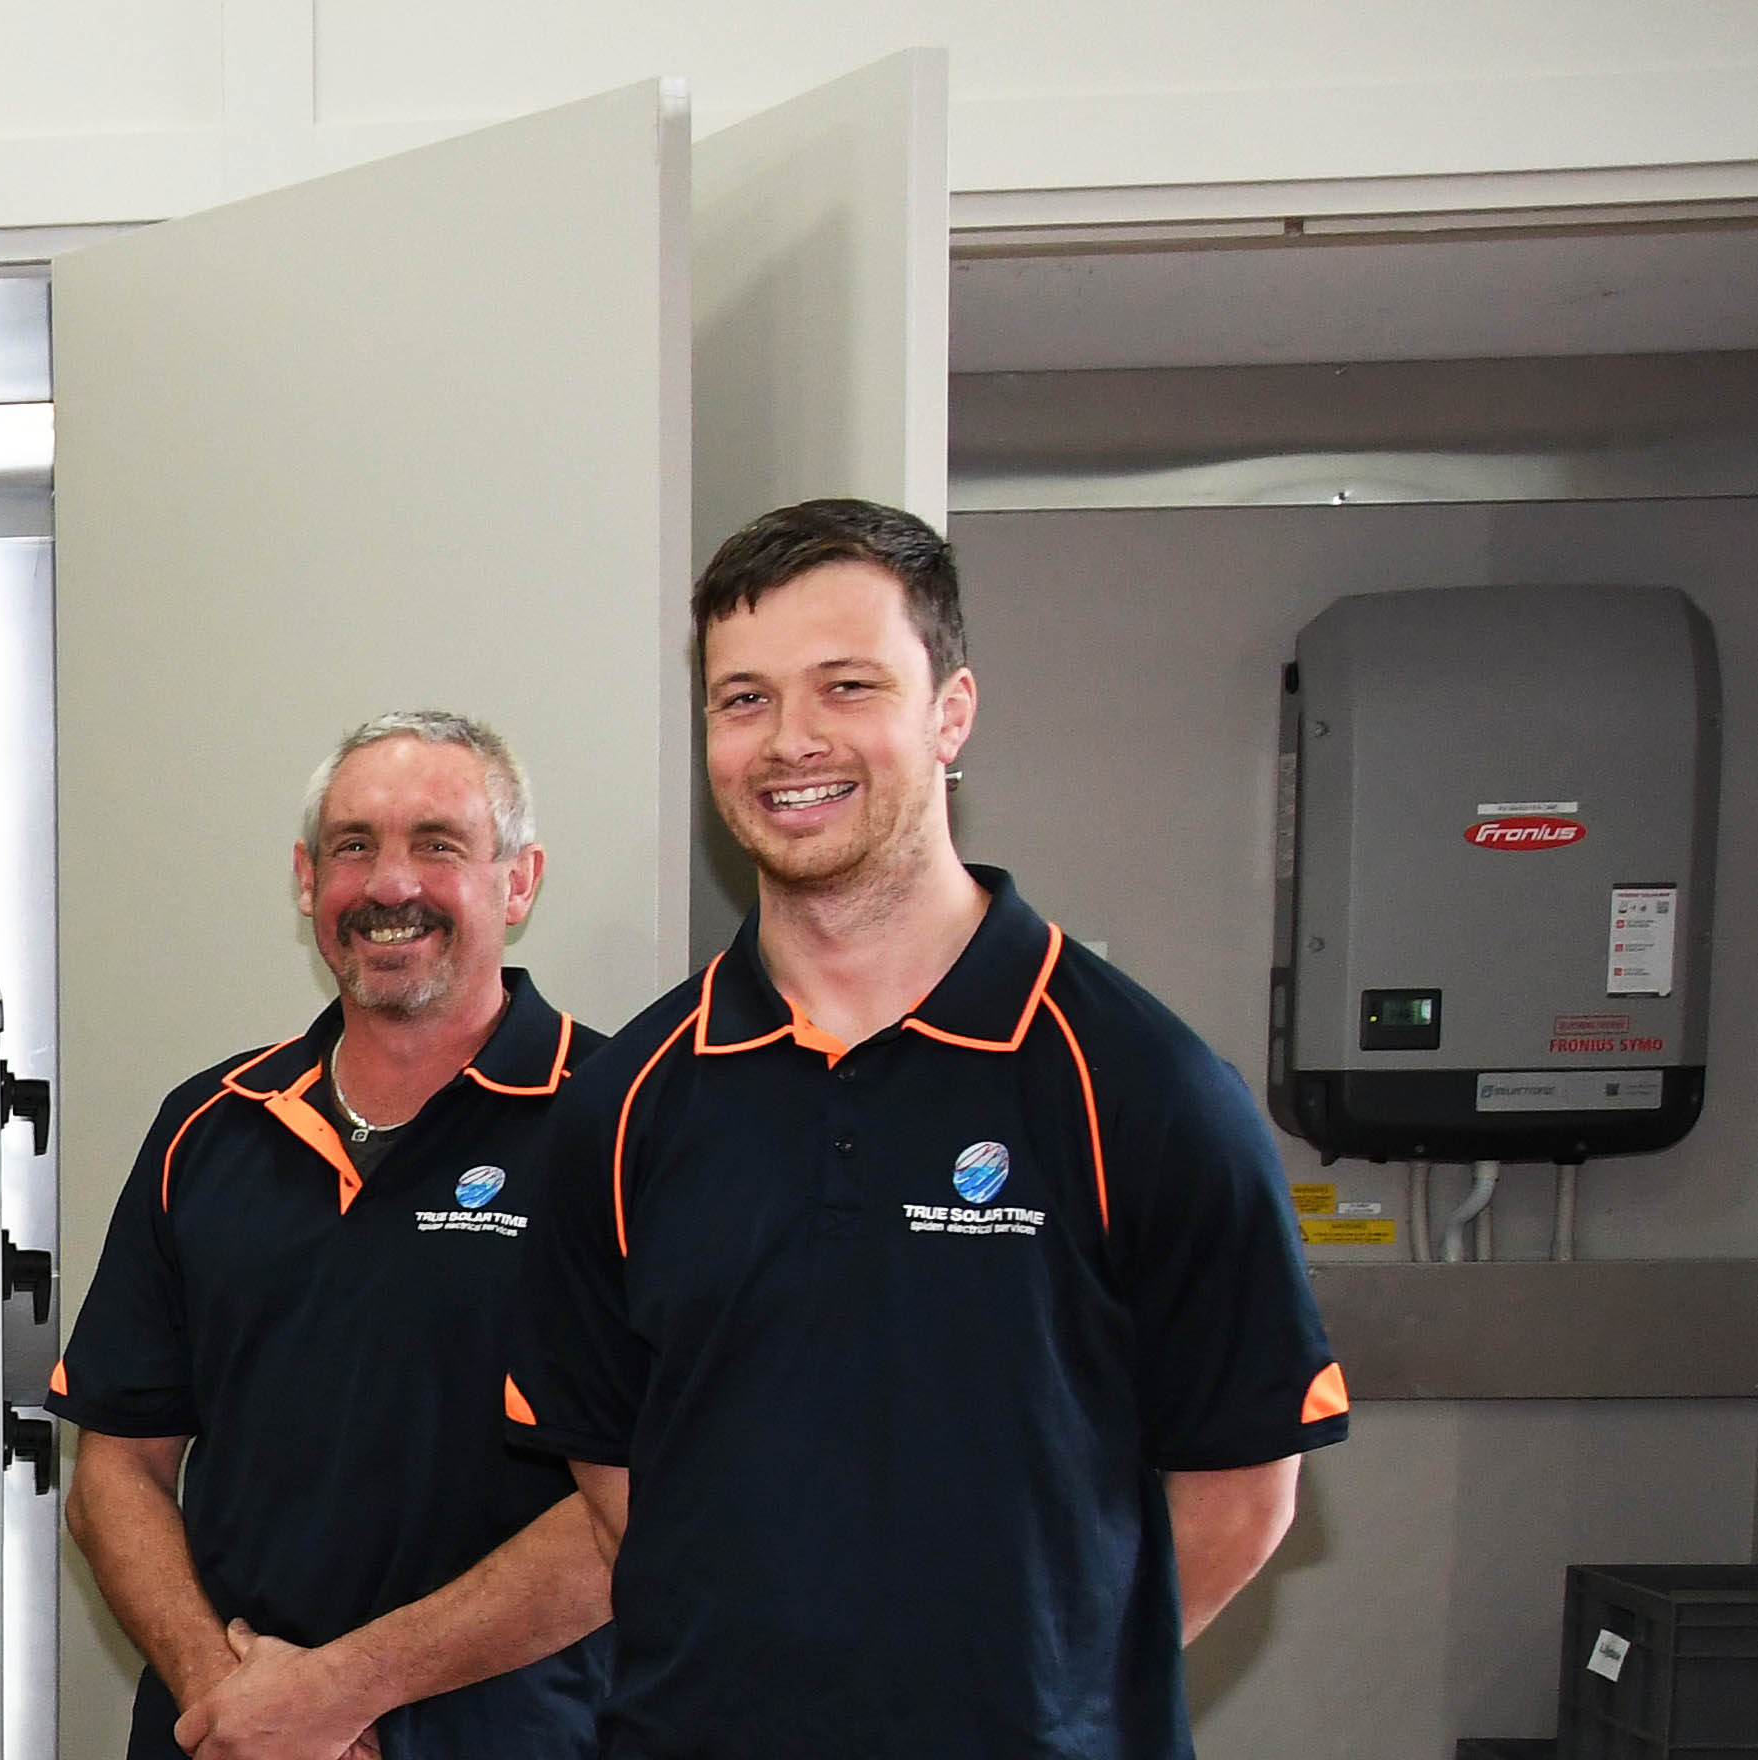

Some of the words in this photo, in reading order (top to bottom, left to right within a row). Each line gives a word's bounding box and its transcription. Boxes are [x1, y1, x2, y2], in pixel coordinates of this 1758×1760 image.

[1475, 824, 1578, 843] Fronius
[1549, 1039, 1615, 1052] FRONIUS
[1619, 1037, 1663, 1052] SYMO
[415, 1211, 448, 1222] TRUE
[449, 1211, 493, 1222] SOLAR
[493, 1211, 528, 1228] TIME
[903, 1204, 948, 1220] TRUE
[950, 1208, 1003, 1222] SOLAR
[1004, 1208, 1045, 1226] TIME
[947, 1223, 993, 1234] electrical
[994, 1223, 1036, 1236] services
